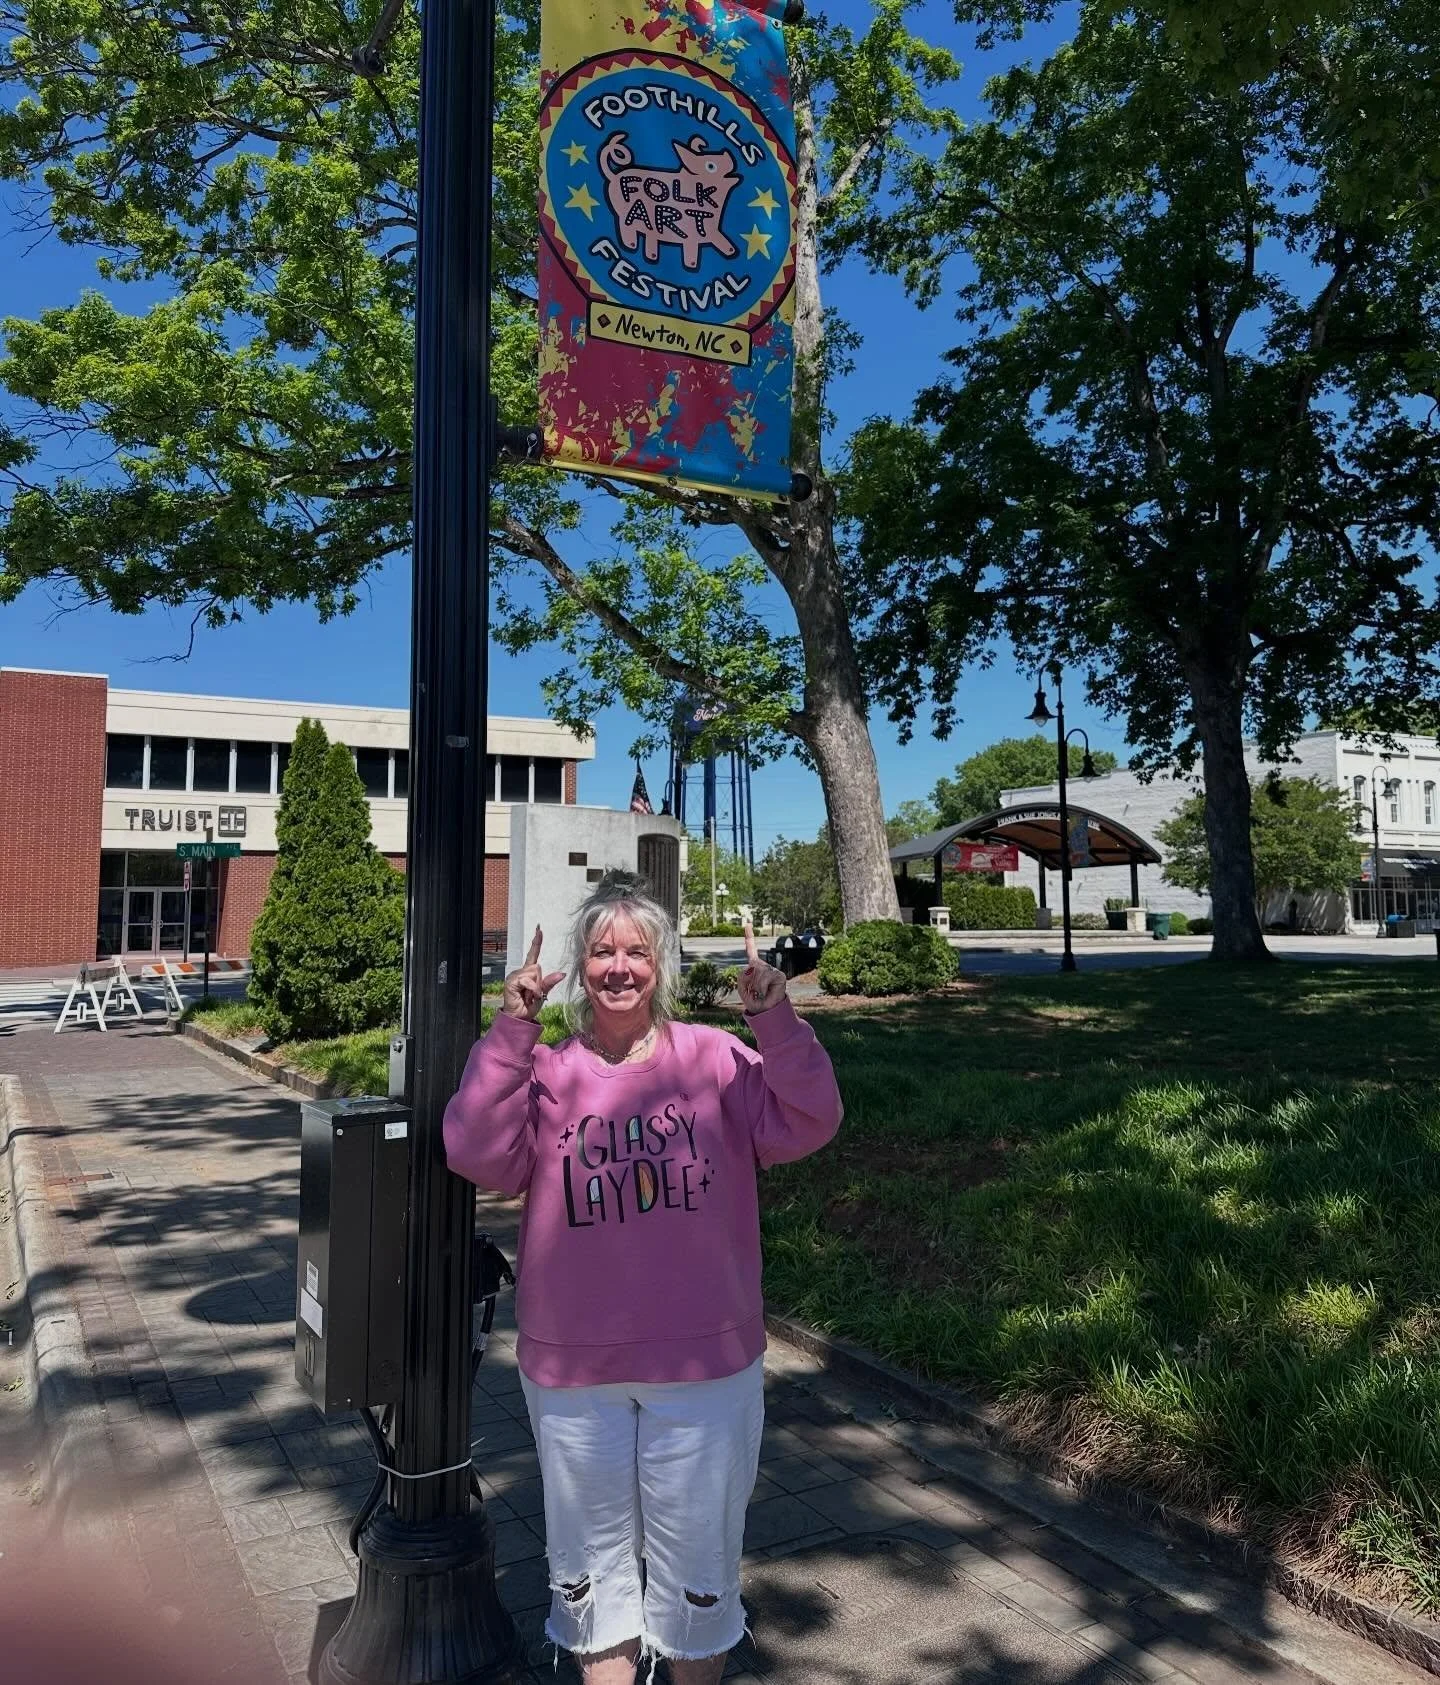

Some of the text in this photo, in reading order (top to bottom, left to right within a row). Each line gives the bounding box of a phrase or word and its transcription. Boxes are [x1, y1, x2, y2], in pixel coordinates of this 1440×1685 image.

[584, 86, 764, 166] FOOTHILLS
[620, 176, 718, 208] FOLK
[625, 199, 714, 238] ART
[591, 239, 750, 312] FESTIVAL
[615, 313, 726, 354] Newton, NC
[125, 808, 213, 831] TRUIST
[191, 845, 216, 857] MAIN
[577, 1103, 698, 1170] GLASSY
[563, 1156, 699, 1228] LAYDEE
